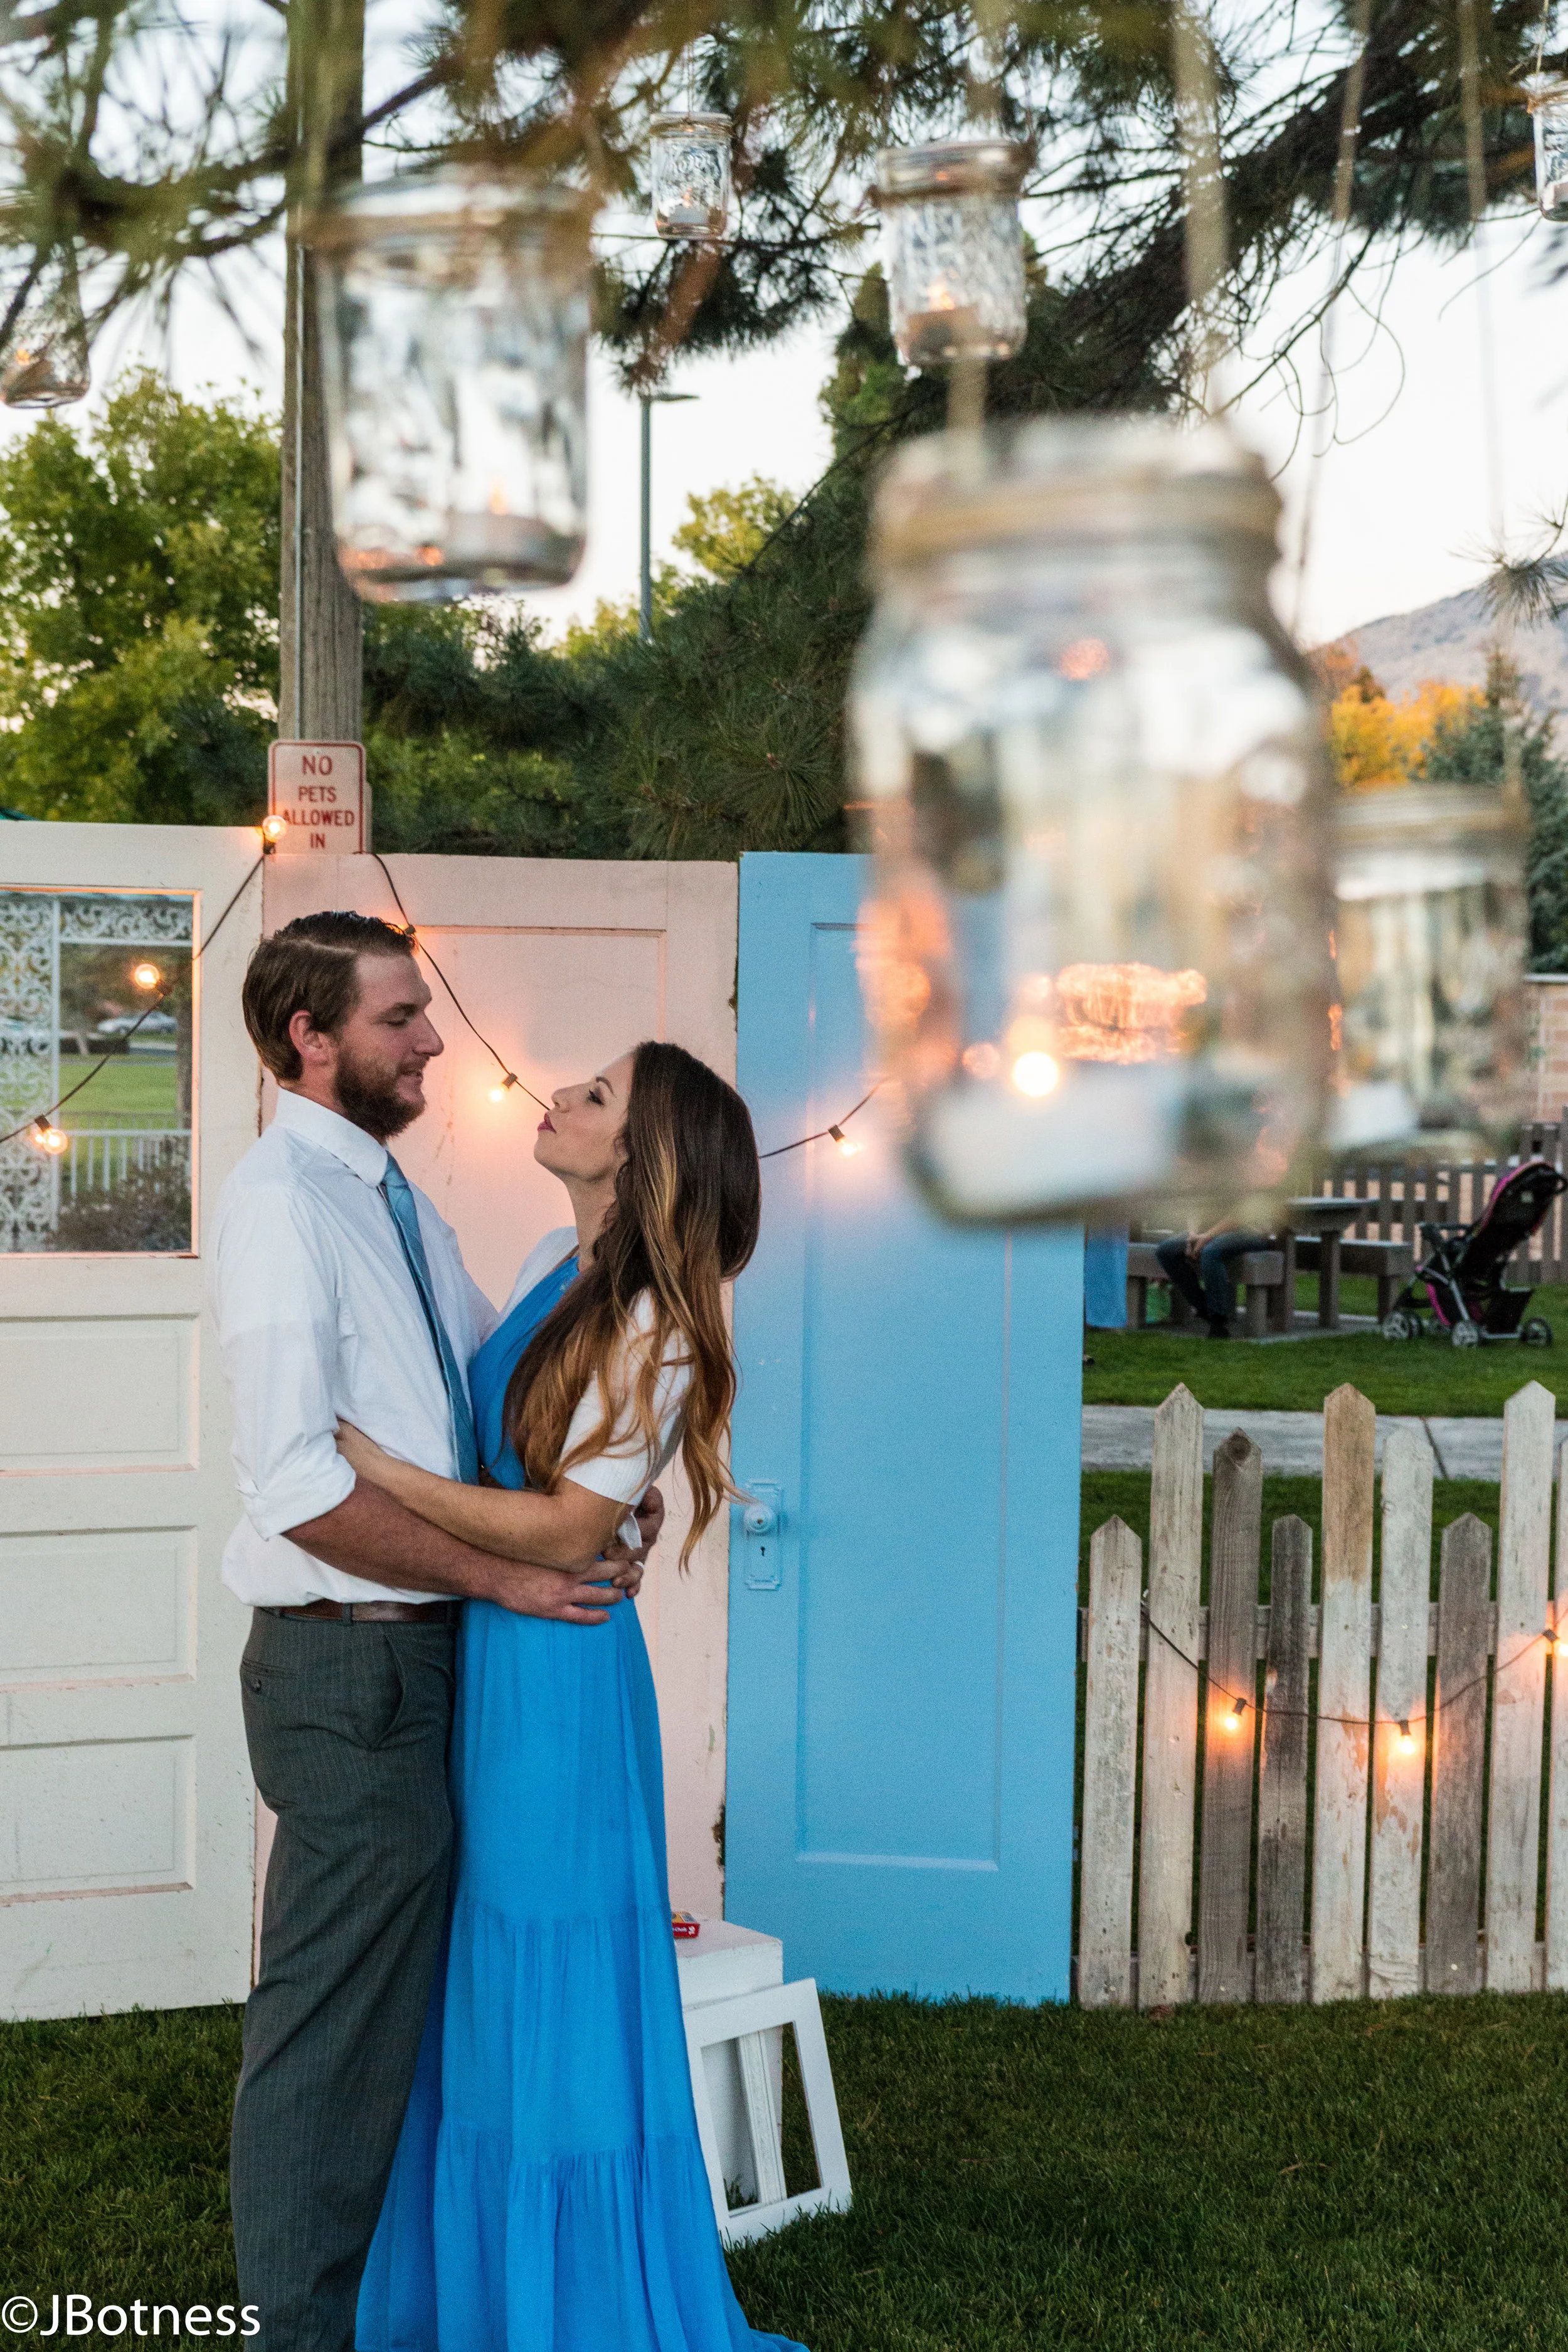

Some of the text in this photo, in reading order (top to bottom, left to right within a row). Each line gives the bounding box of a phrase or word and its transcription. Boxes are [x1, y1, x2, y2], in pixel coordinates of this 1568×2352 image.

[302, 755, 333, 776] NO
[298, 786, 337, 803] PETS
[283, 809, 355, 826] ALLOWED
[310, 832, 326, 849] IN
